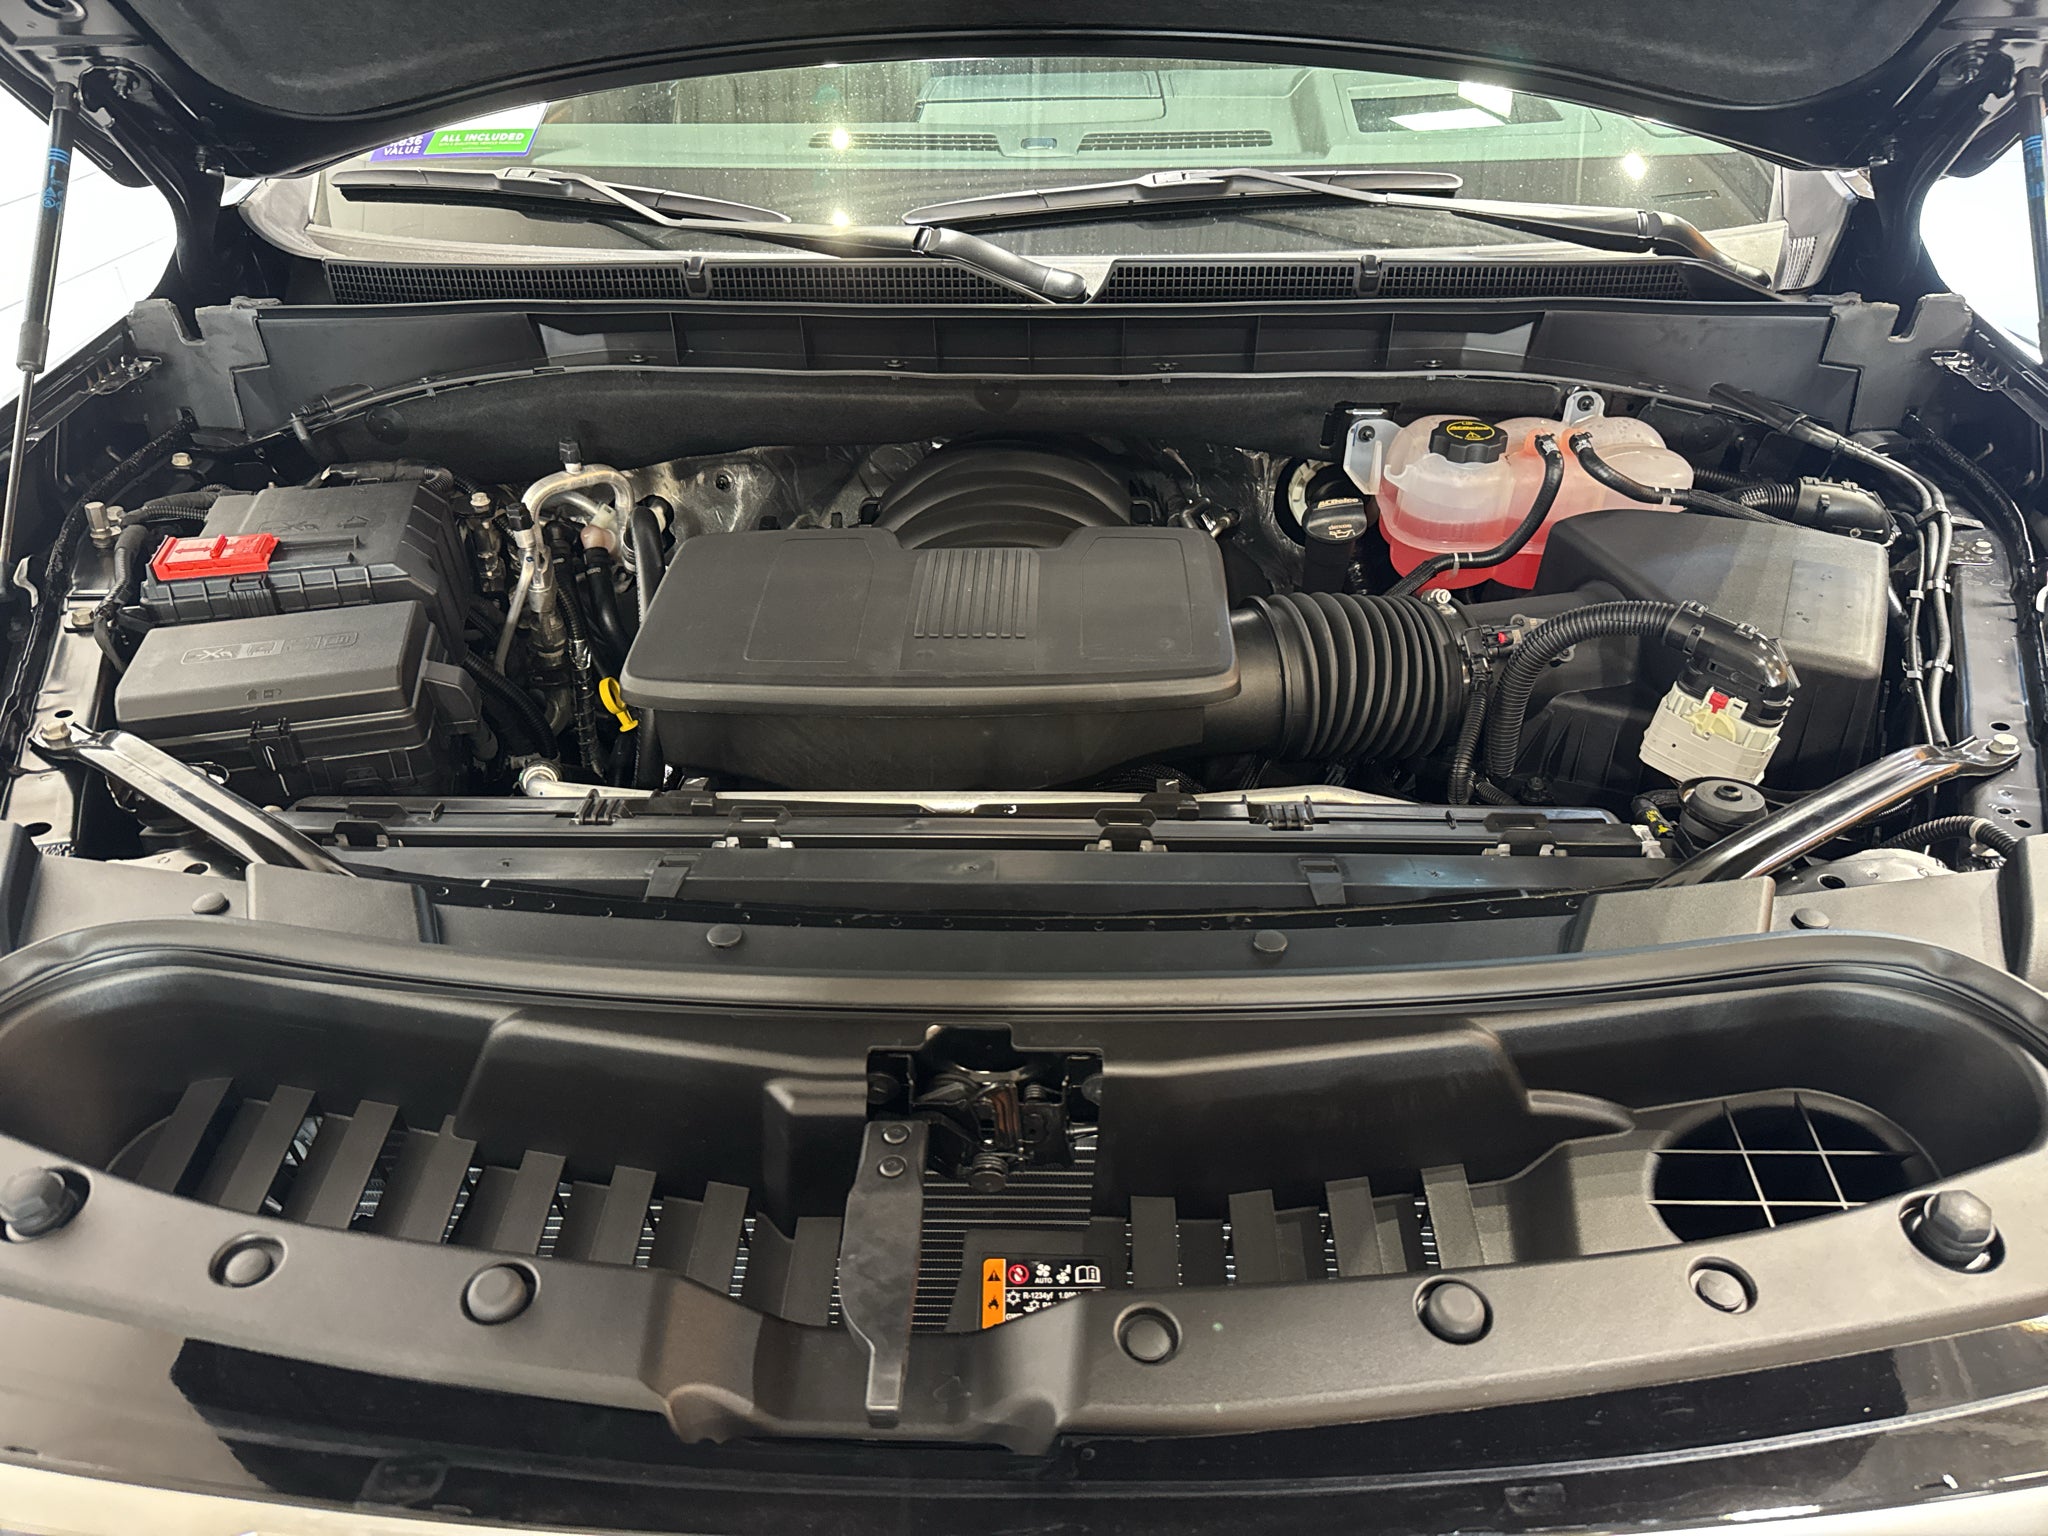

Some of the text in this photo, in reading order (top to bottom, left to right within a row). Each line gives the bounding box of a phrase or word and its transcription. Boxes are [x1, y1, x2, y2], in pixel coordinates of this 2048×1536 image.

[440, 132, 525, 143] ALL INCLUDED
[384, 145, 421, 156] VALUE
[1317, 497, 1359, 509] ACDelco
[1022, 1291, 1054, 1301] R-1234yf
